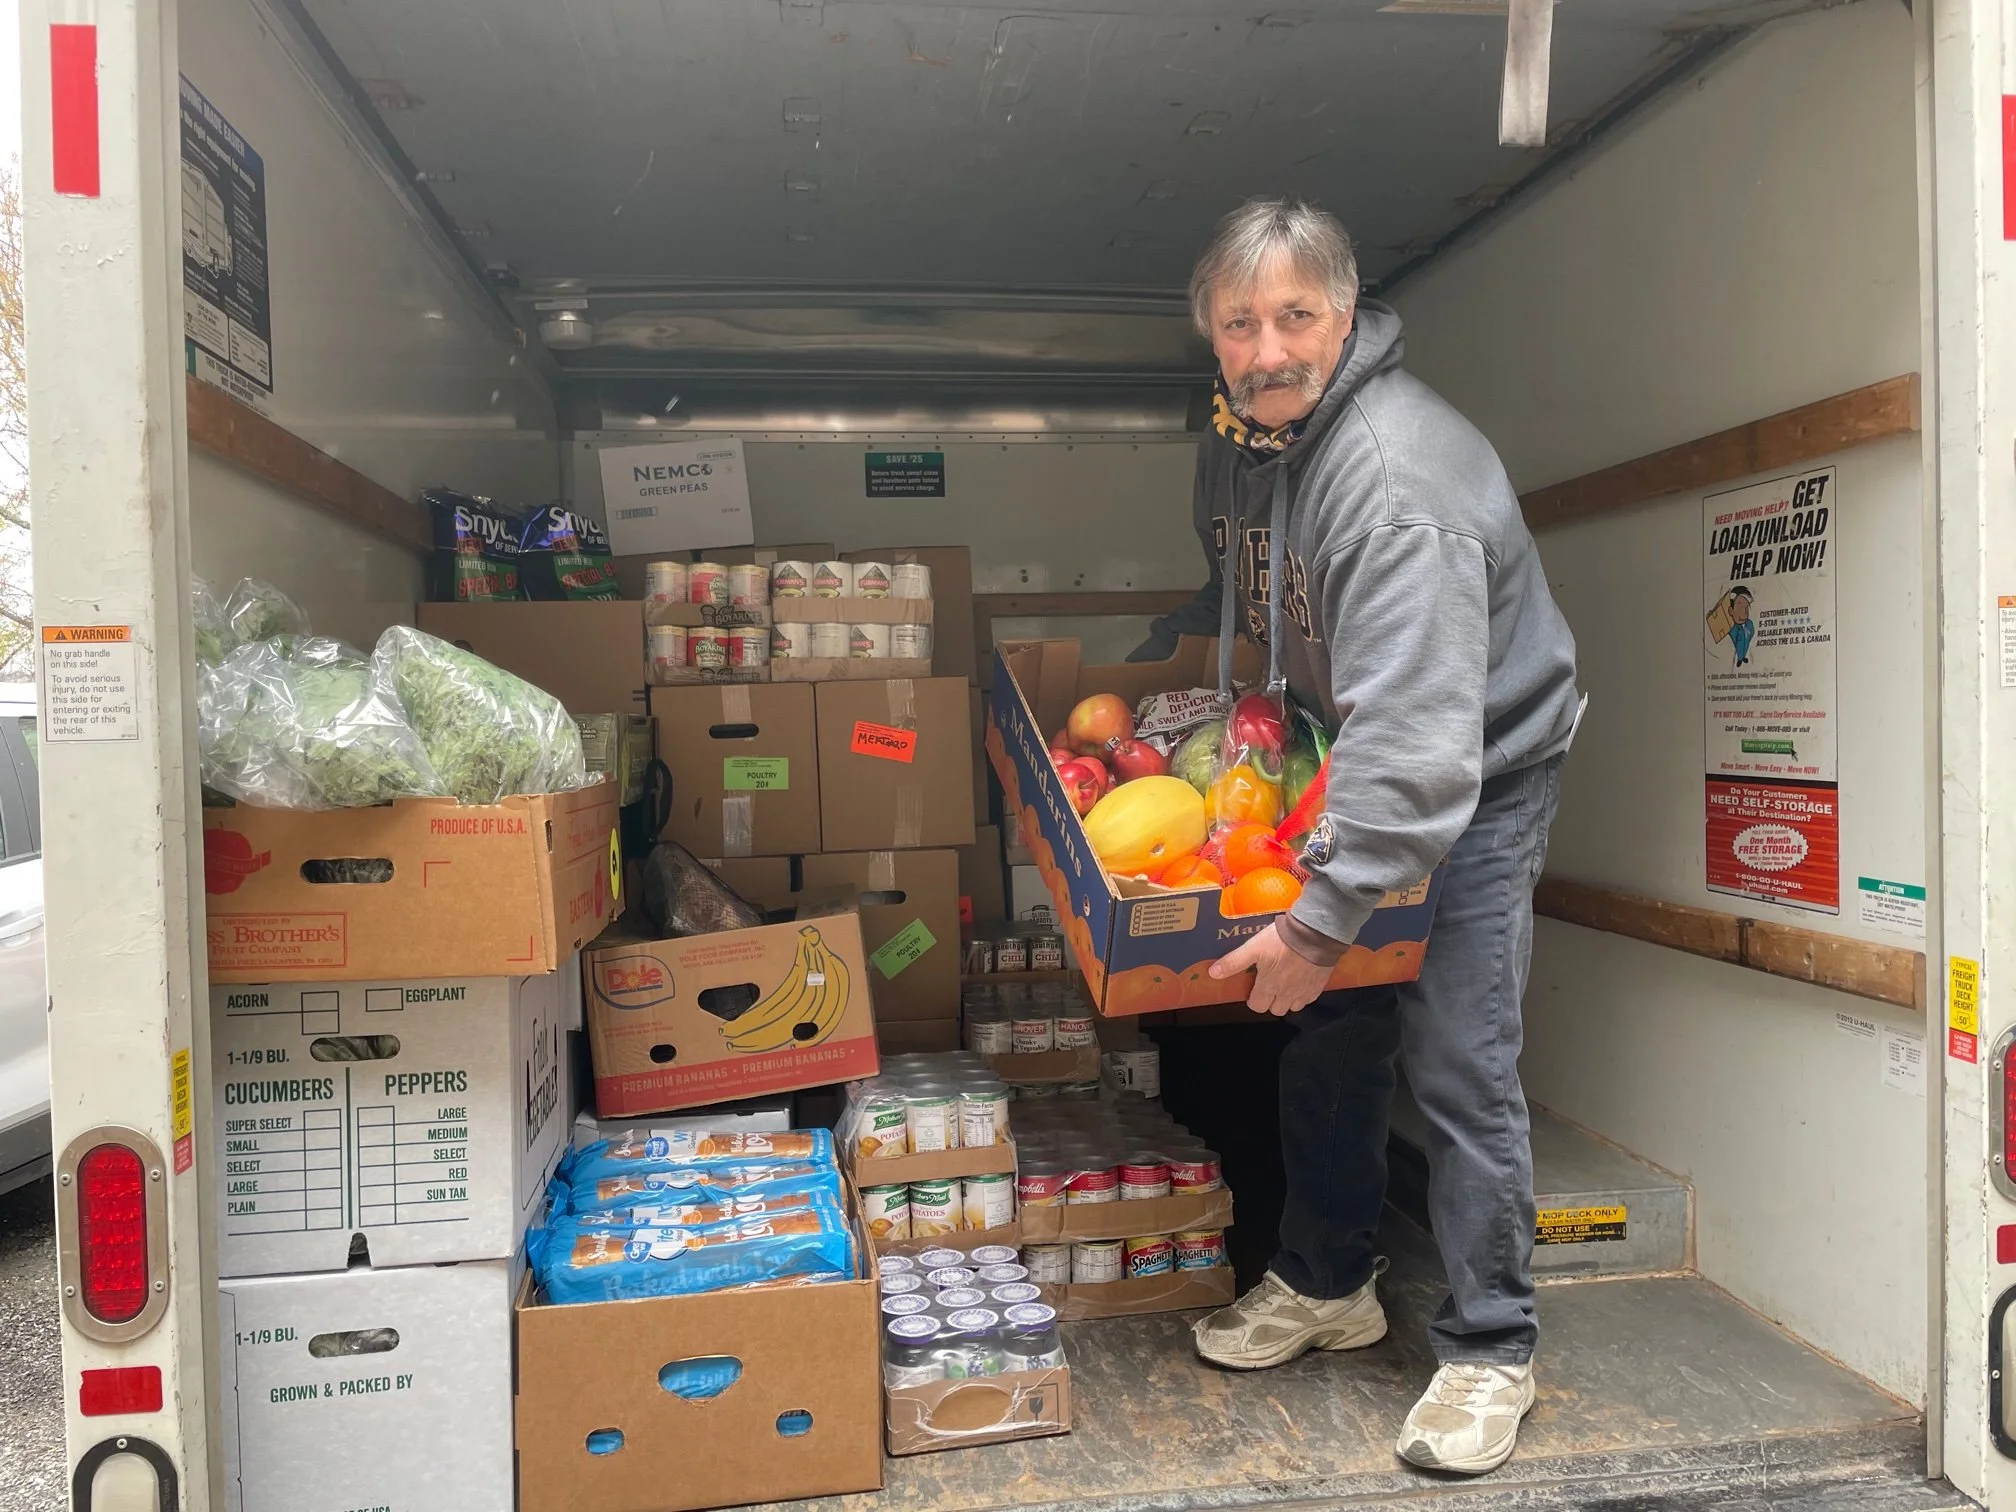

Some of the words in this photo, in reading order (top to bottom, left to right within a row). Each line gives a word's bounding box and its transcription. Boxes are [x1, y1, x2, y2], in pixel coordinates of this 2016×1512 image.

[886, 455, 907, 464] SAVE
[639, 486, 677, 497] GREEN
[680, 482, 709, 494] PEAS
[1792, 475, 1829, 509] GET
[1715, 513, 1733, 526] NEED
[1735, 506, 1763, 523] MOVING
[1764, 500, 1789, 515] HELP?
[1709, 507, 1829, 556] LOAD/UNLOAD
[459, 559, 486, 570] LIMITED
[557, 558, 582, 567] LIMITED
[1730, 549, 1773, 581] HELP
[1775, 540, 1827, 574] NOW!
[1759, 606, 1808, 618] CUSTOMER-RATED
[70, 629, 124, 640] WARNING
[1757, 628, 1782, 638] RELIABLE
[1783, 626, 1806, 636] MOVING
[1756, 638, 1777, 648] ACROSS
[1778, 637, 1788, 646] THE
[1807, 634, 1831, 643] CANADA
[50, 650, 62, 658] No
[64, 649, 82, 659] grab
[84, 649, 111, 658] handle
[52, 675, 62, 683] To
[64, 674, 87, 683] avoid
[90, 674, 121, 683] serious
[52, 686, 77, 695] injury,
[79, 685, 90, 693] do
[93, 685, 107, 693] not
[109, 685, 125, 693] use
[52, 695, 68, 704] this
[70, 695, 88, 704] side
[90, 695, 103, 703] for
[1166, 692, 1190, 703] RED
[53, 706, 88, 715] entering
[102, 705, 131, 714] exiting
[1169, 694, 1221, 714] DELICIOU
[53, 716, 67, 724] the
[90, 716, 99, 724] of
[101, 715, 116, 723] this
[1157, 712, 1186, 726] SWEET
[1189, 706, 1206, 718] AND
[1208, 705, 1230, 715] JUICY
[1802, 711, 1826, 719] Available
[53, 726, 85, 734] vehicle.
[1734, 725, 1747, 733] Today
[1721, 762, 1734, 770] Move
[1734, 762, 1750, 770] Smart
[1755, 764, 1769, 772] Move
[1770, 765, 1782, 773] Easy
[1803, 766, 1820, 774] NOW!
[1011, 706, 1082, 878] Mandarins
[1731, 787, 1741, 795] Do
[1743, 788, 1760, 796] Your
[1762, 790, 1808, 800] Customers
[1710, 794, 1739, 806] NEED
[1743, 797, 1833, 815] SELF-STORAGE
[1737, 808, 1757, 817] Their
[1759, 810, 1812, 822] Destination?
[430, 818, 478, 835] PRODUCE
[481, 818, 495, 835] OF
[497, 818, 527, 834] U.S.A.
[1750, 836, 1764, 845] One
[1766, 836, 1791, 845] Month
[1738, 845, 1760, 855] FREE
[1762, 845, 1803, 855] STORAGE
[1748, 882, 1788, 893] uhaul.com
[233, 925, 340, 943] BROTHER'S
[212, 945, 245, 955] FRUIT
[248, 944, 304, 954] COMPANY
[896, 936, 921, 958] POULTRY
[1956, 961, 1973, 970] TYPICAL
[607, 963, 663, 990] Dole
[1952, 969, 1976, 980] FREIGHT
[1955, 980, 1973, 992] TRUCK
[227, 993, 269, 1008] ACORN
[405, 987, 467, 1003] EGGPLANT
[1956, 990, 1971, 1001] DECK
[1953, 1000, 1973, 1012] HEIGHT
[1854, 1019, 1876, 1031] U-HAUL
[227, 1050, 263, 1065] 1-1/9
[266, 1049, 290, 1063] BU.
[622, 1076, 674, 1093] PREMIUM
[675, 1068, 728, 1085] BANANAS
[742, 1055, 793, 1074] PREMIUM
[795, 1047, 846, 1066] BANANAS
[385, 1070, 468, 1096] PEPPERS
[225, 1077, 334, 1105] CUCUMBERS
[438, 1107, 467, 1119] LARGE
[225, 1119, 257, 1132] SUPER
[259, 1117, 292, 1130] SELECT
[427, 1127, 468, 1140] MEDIUM
[226, 1140, 260, 1152] SMALL
[433, 1147, 467, 1160] SELECT
[226, 1160, 261, 1173] SELECT
[448, 1167, 467, 1179] RED
[227, 1181, 258, 1193] LARGE
[427, 1188, 447, 1201] SUN
[449, 1187, 467, 1199] TAN
[227, 1201, 256, 1213] PLAIN
[1542, 1211, 1564, 1220] MOP
[1595, 1208, 1618, 1216] ONLY
[235, 1329, 271, 1346] 1-1/9
[274, 1327, 299, 1343] BU.
[270, 1383, 318, 1403] GROWN
[323, 1383, 333, 1397] &
[339, 1376, 391, 1396] PACKED
[396, 1374, 414, 1390] BY
